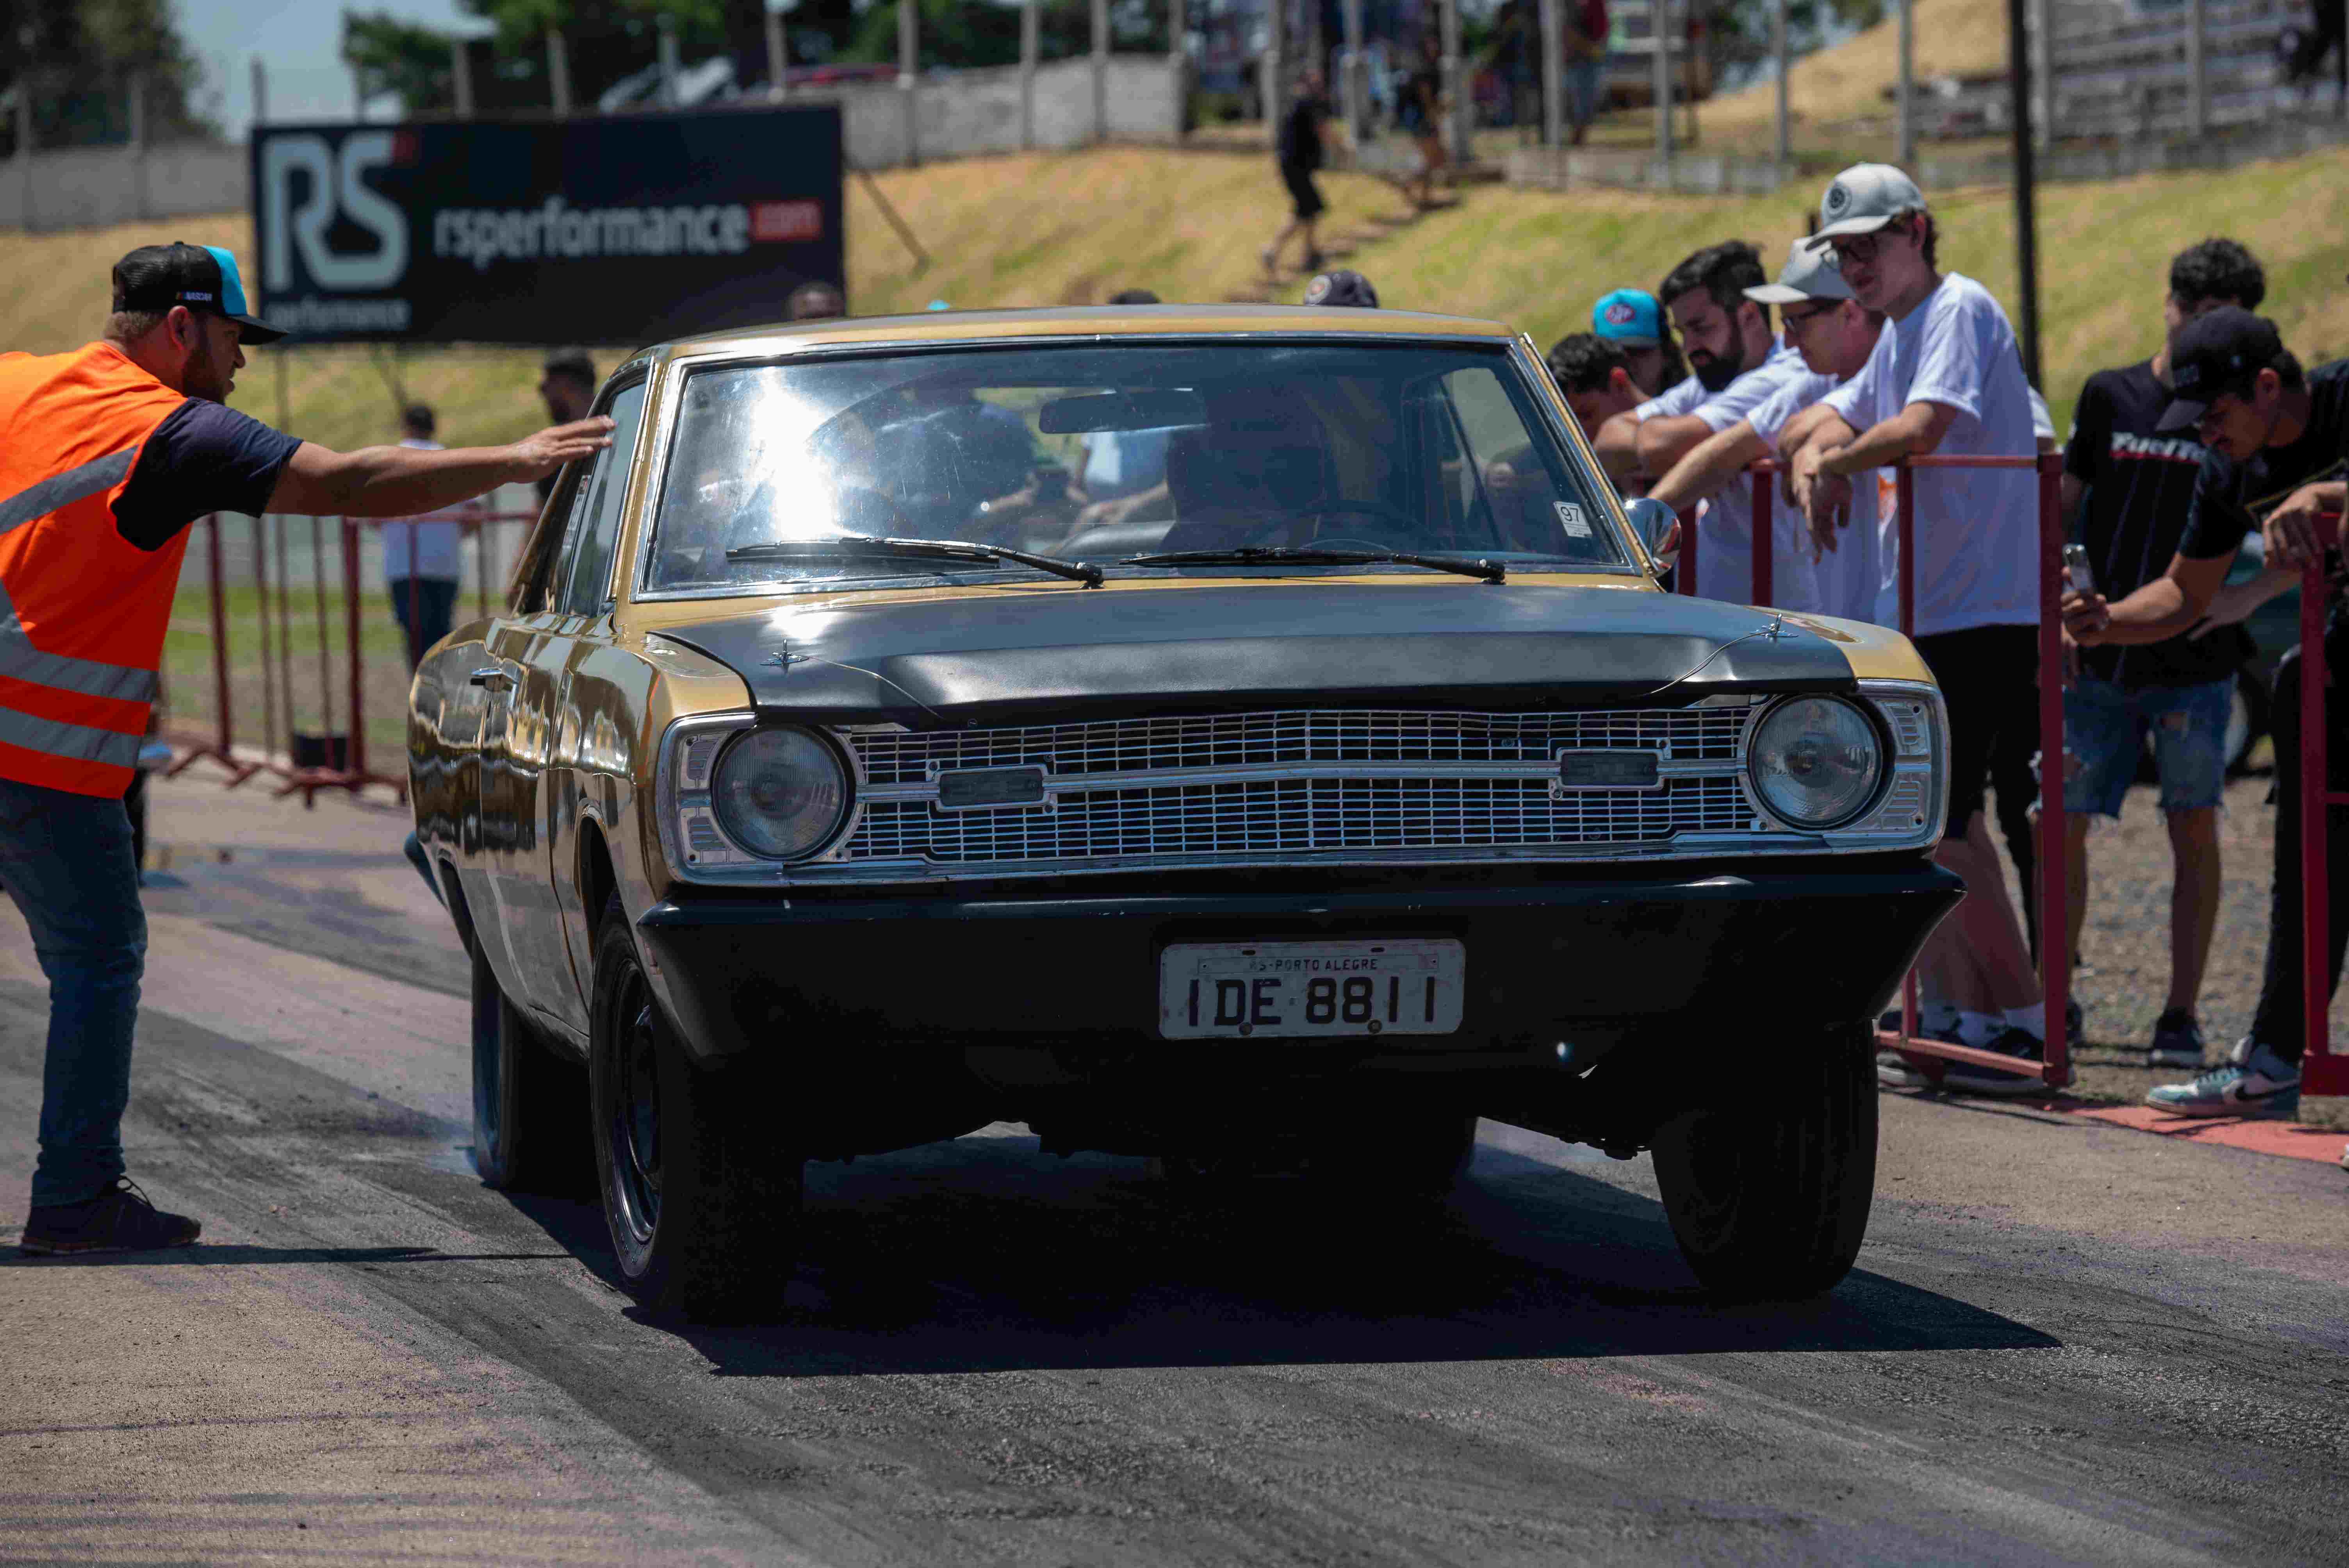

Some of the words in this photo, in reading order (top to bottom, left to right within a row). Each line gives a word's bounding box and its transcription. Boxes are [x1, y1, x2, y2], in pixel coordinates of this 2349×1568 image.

[264, 134, 411, 292] RS
[186, 291, 213, 301] NASCAR
[1560, 506, 1579, 523] 97
[1324, 959, 1378, 971] ALEGRE
[1306, 976, 1435, 1024] 8811
